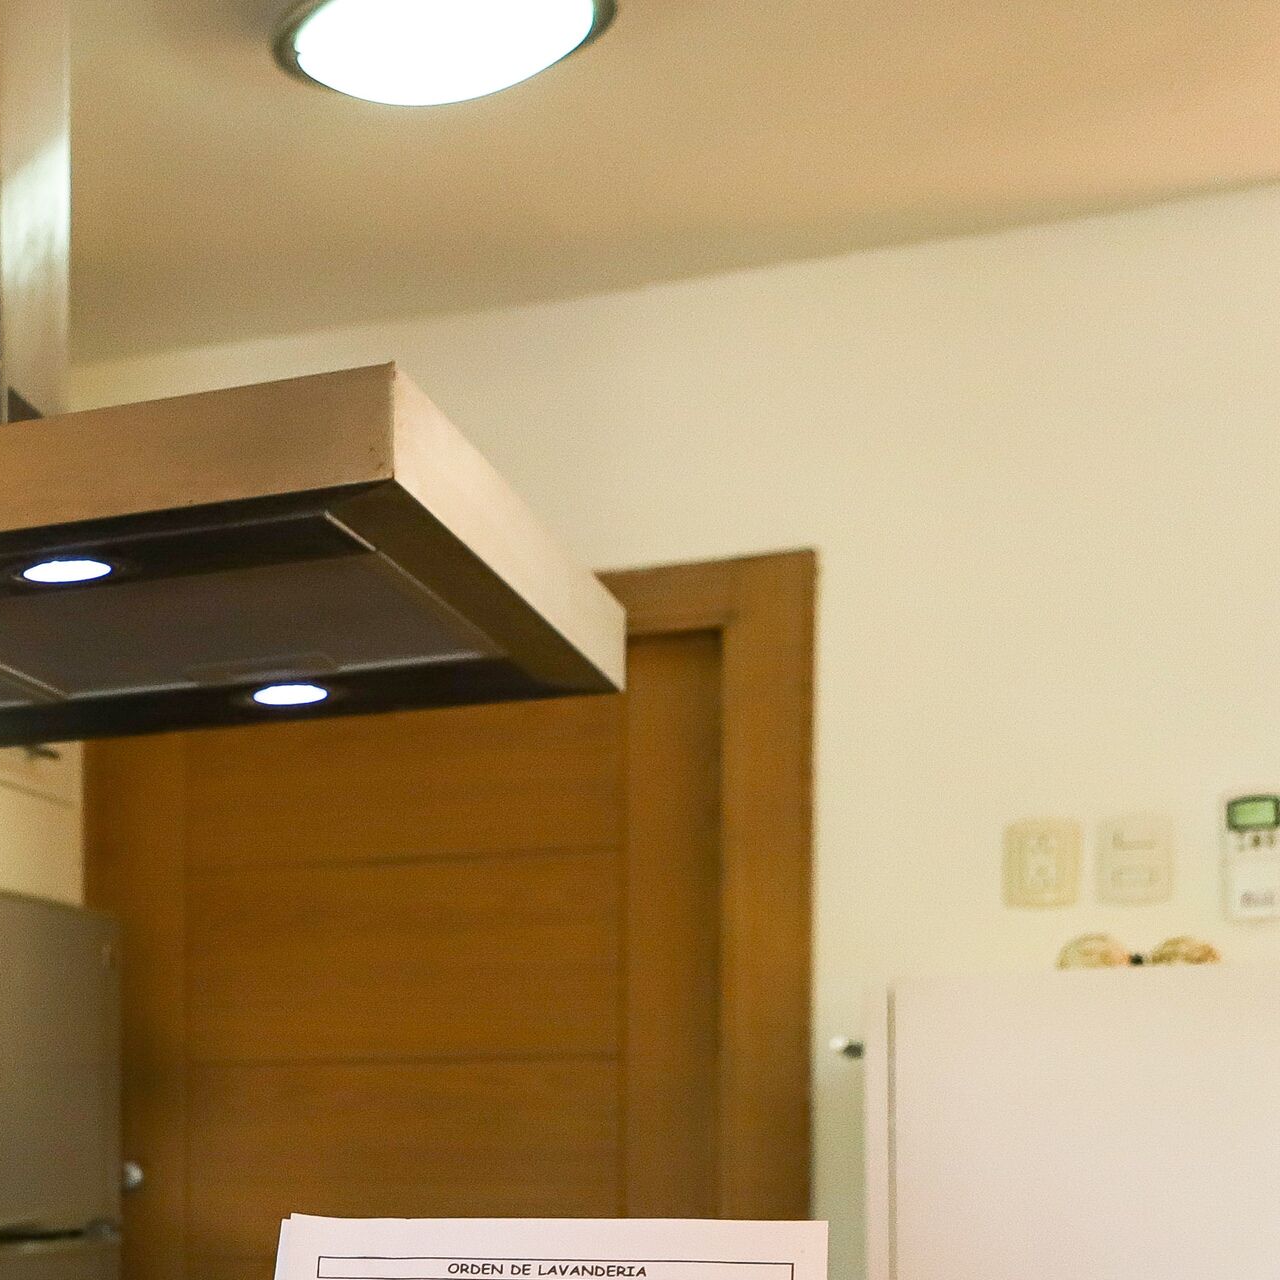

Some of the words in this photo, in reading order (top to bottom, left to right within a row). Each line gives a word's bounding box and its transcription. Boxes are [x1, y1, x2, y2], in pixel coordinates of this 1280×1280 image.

[447, 1262, 504, 1276] ORDEN
[510, 1264, 532, 1276] DE
[538, 1264, 647, 1277] LAVANDERIA
